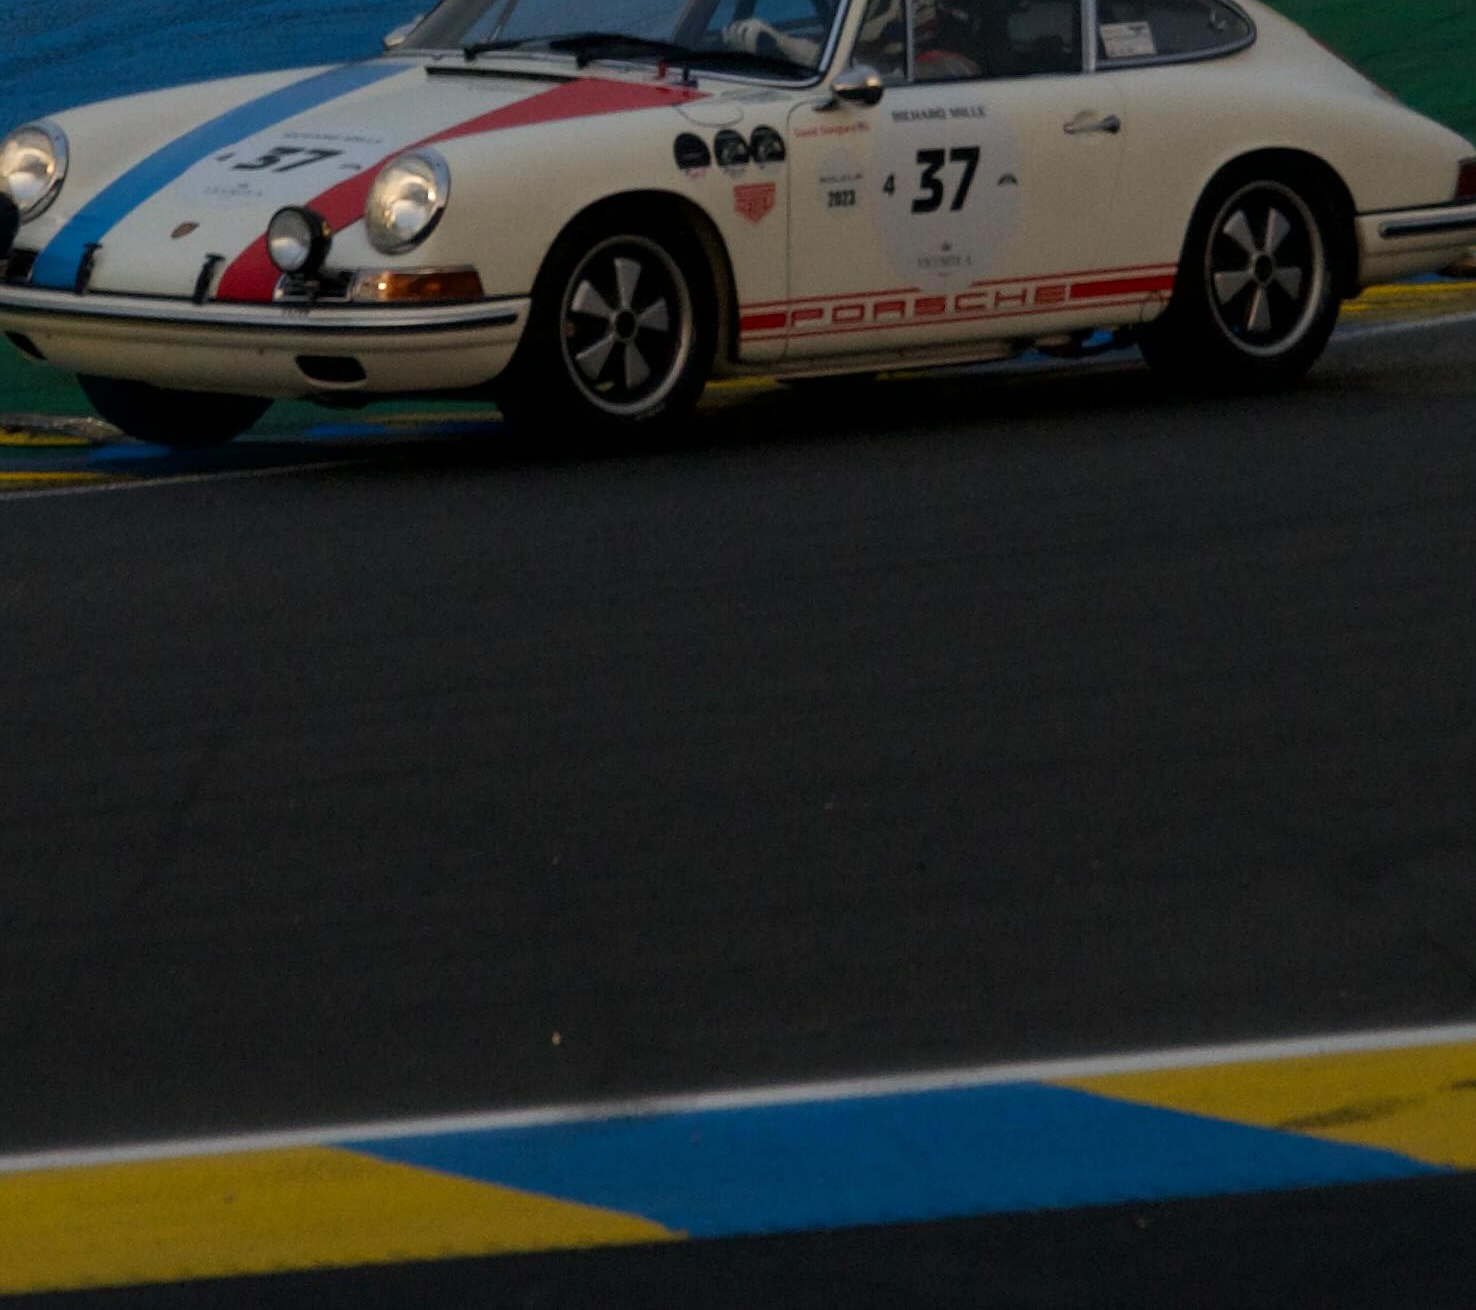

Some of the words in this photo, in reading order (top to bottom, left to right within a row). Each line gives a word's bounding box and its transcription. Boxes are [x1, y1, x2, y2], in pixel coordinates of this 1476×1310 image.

[232, 145, 343, 173] 37
[883, 173, 896, 196] 4
[910, 146, 981, 214] 37
[827, 188, 856, 208] 2023
[790, 285, 1067, 328] PORSCHE
